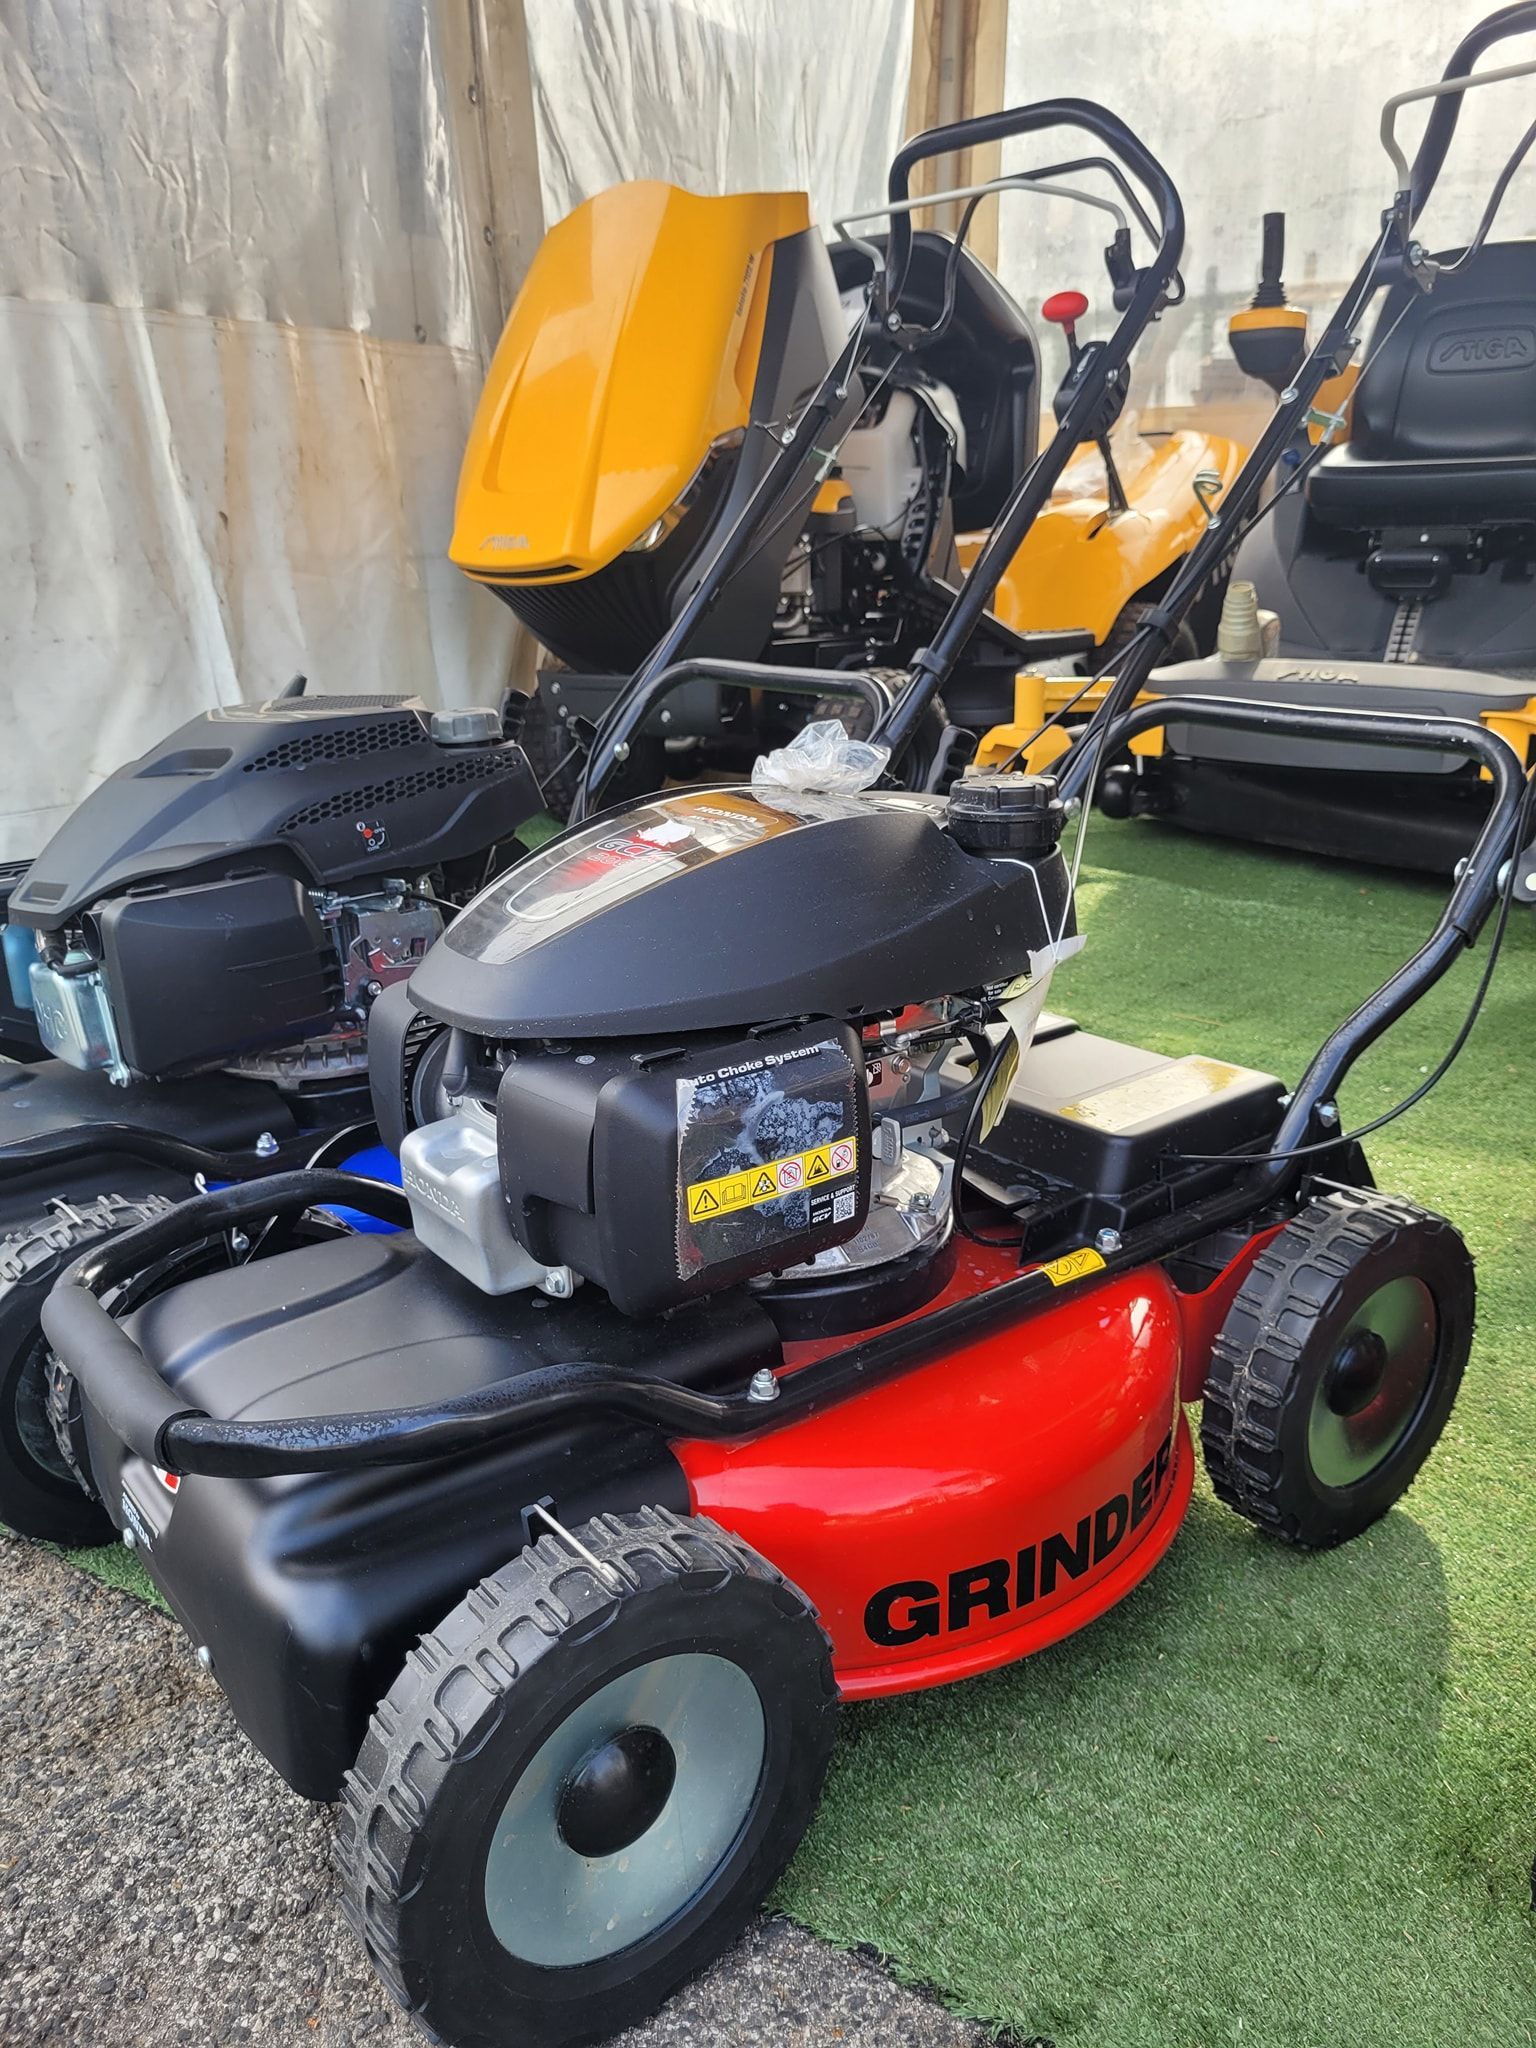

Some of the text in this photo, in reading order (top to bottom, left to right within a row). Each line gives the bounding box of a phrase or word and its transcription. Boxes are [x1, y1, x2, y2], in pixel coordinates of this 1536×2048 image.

[1439, 336, 1528, 363] STIGA
[1277, 668, 1358, 684] STIGA
[694, 806, 757, 823] HONDA
[597, 838, 677, 859] GCV
[678, 1045, 820, 1090] Auto Choke System
[402, 1166, 466, 1224] HONDA
[810, 1193, 831, 1206] SERVICE
[834, 1184, 856, 1197] SUPPORT
[812, 1211, 832, 1223] GCV
[863, 1427, 1173, 1648] GRINDER
